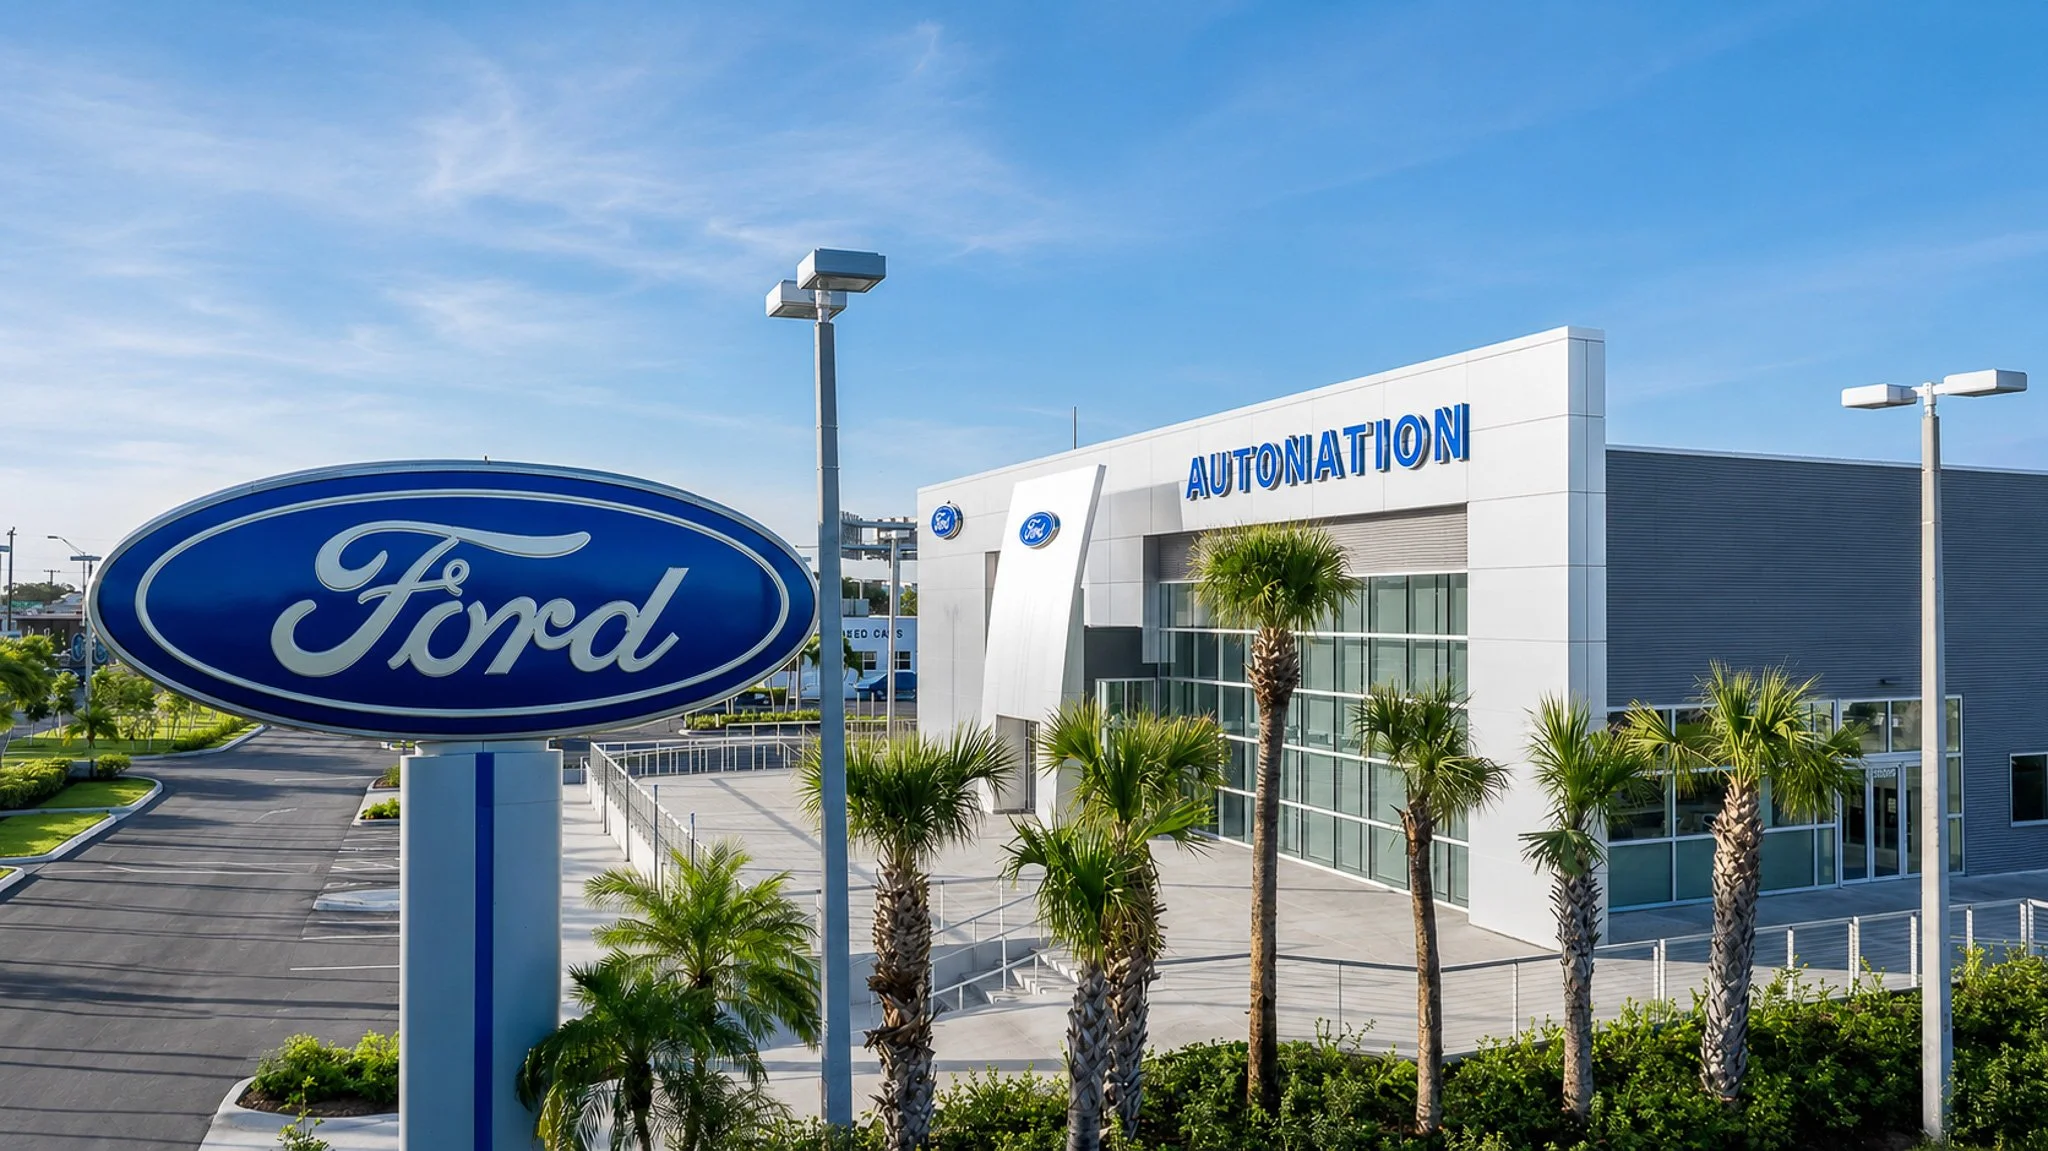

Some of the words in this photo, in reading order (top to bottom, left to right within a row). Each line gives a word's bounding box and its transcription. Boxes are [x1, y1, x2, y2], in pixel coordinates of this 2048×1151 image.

[1186, 402, 1470, 500] AUTONATION
[935, 512, 951, 531] Ford
[1024, 518, 1046, 540] Ford
[271, 520, 690, 677] Ford
[873, 629, 904, 639] CAS
